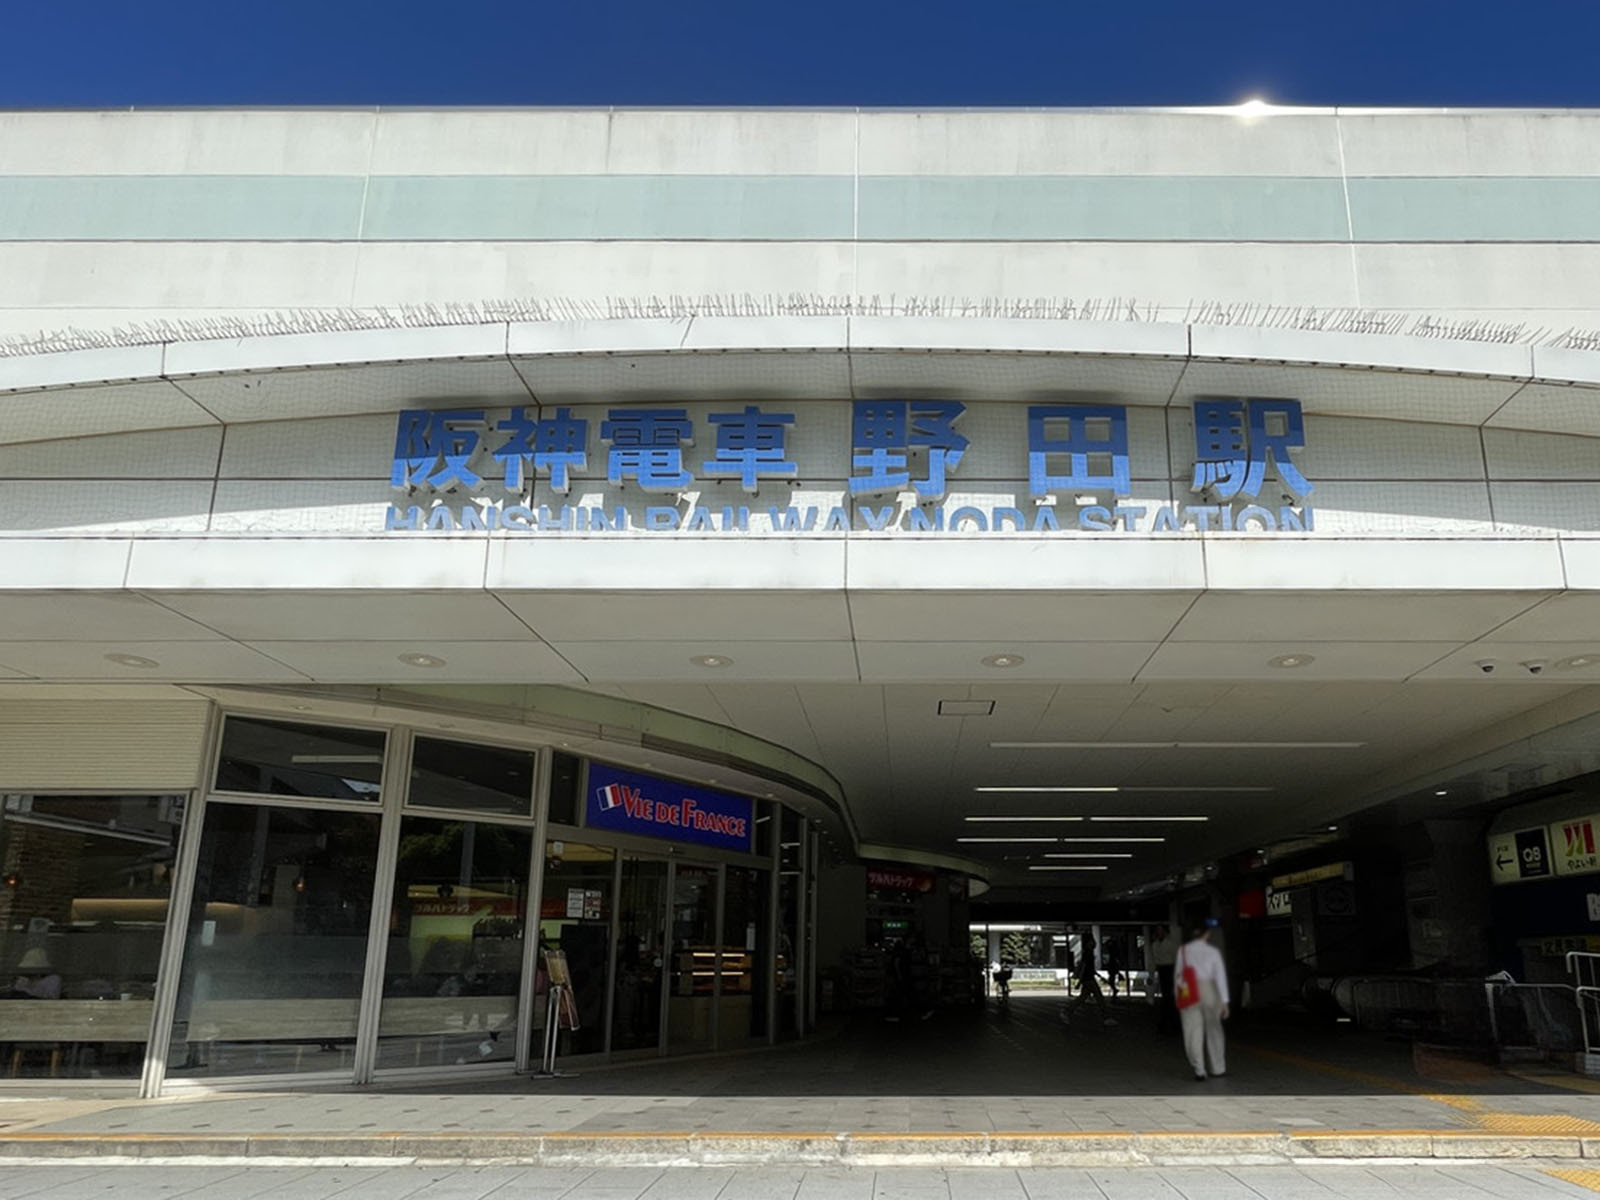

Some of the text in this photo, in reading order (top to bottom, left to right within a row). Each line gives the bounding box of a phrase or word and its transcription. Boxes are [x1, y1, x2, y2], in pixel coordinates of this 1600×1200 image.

[388, 401, 1316, 497] 阪神電車 野田駅
[385, 505, 626, 530] HANSHIN
[1078, 505, 1313, 530] STATION
[681, 798, 746, 838] FRANCE
